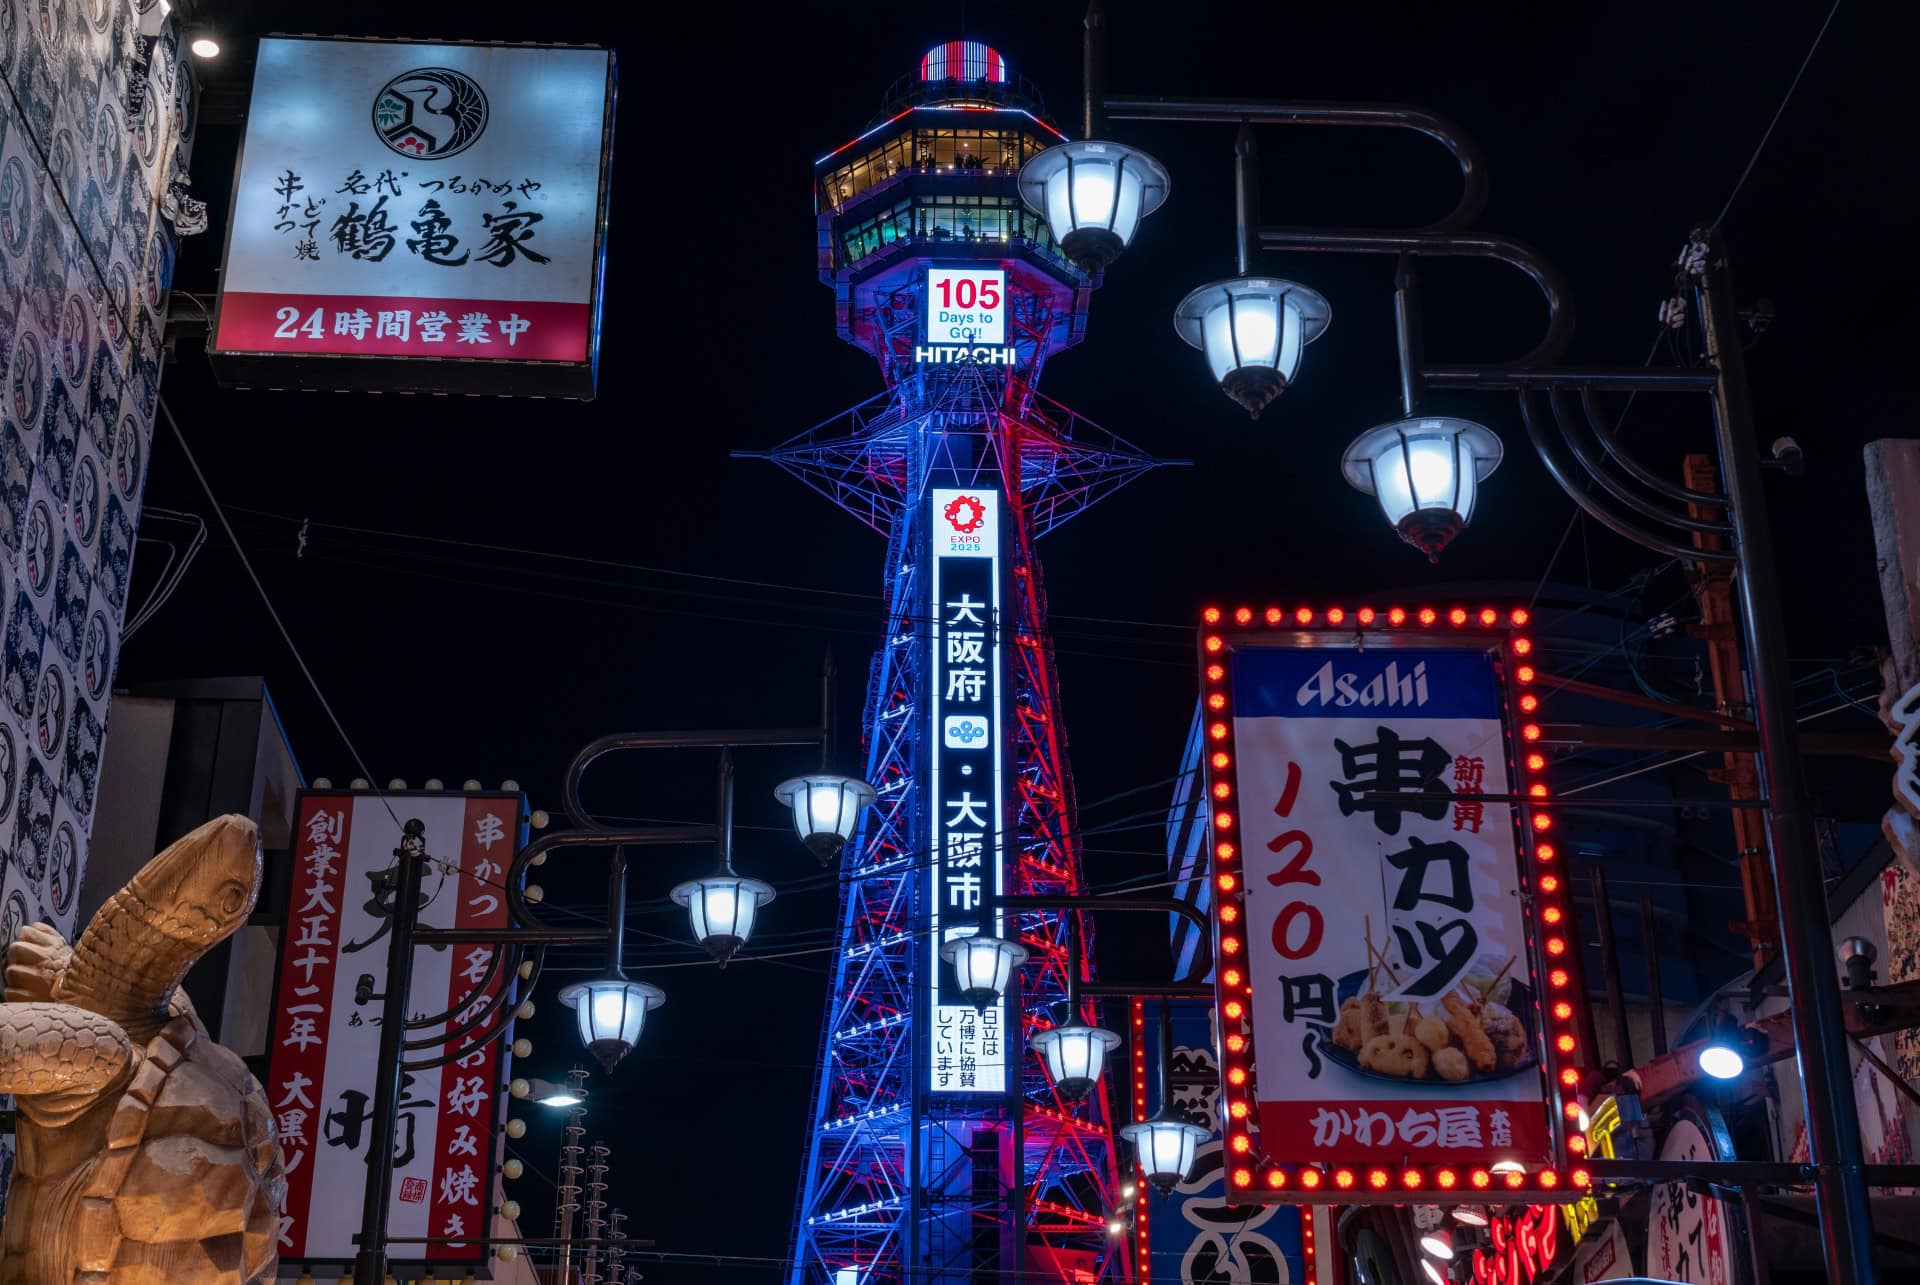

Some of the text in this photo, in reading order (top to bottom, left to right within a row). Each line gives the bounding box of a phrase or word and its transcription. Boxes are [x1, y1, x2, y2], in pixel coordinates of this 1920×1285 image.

[336, 170, 541, 199] 名代 つるかめや
[329, 195, 551, 268] 鶴亀家
[936, 278, 1000, 309] 105
[273, 307, 531, 346] 24時間営業中
[939, 311, 993, 325] Days to
[915, 346, 1016, 365] HITACHI
[950, 535, 981, 544] EXPO
[945, 594, 986, 702] 大阪府
[1296, 660, 1429, 707] Asahi
[468, 813, 504, 917] 串かつ
[1330, 726, 1478, 997] 串カツ
[282, 810, 344, 1052] 創業大正十二年
[937, 1009, 953, 1087] しています
[959, 1009, 976, 1088] 万博に協賛
[982, 1009, 999, 1056] 日立は
[1309, 1106, 1513, 1149] かわち屋 本店
